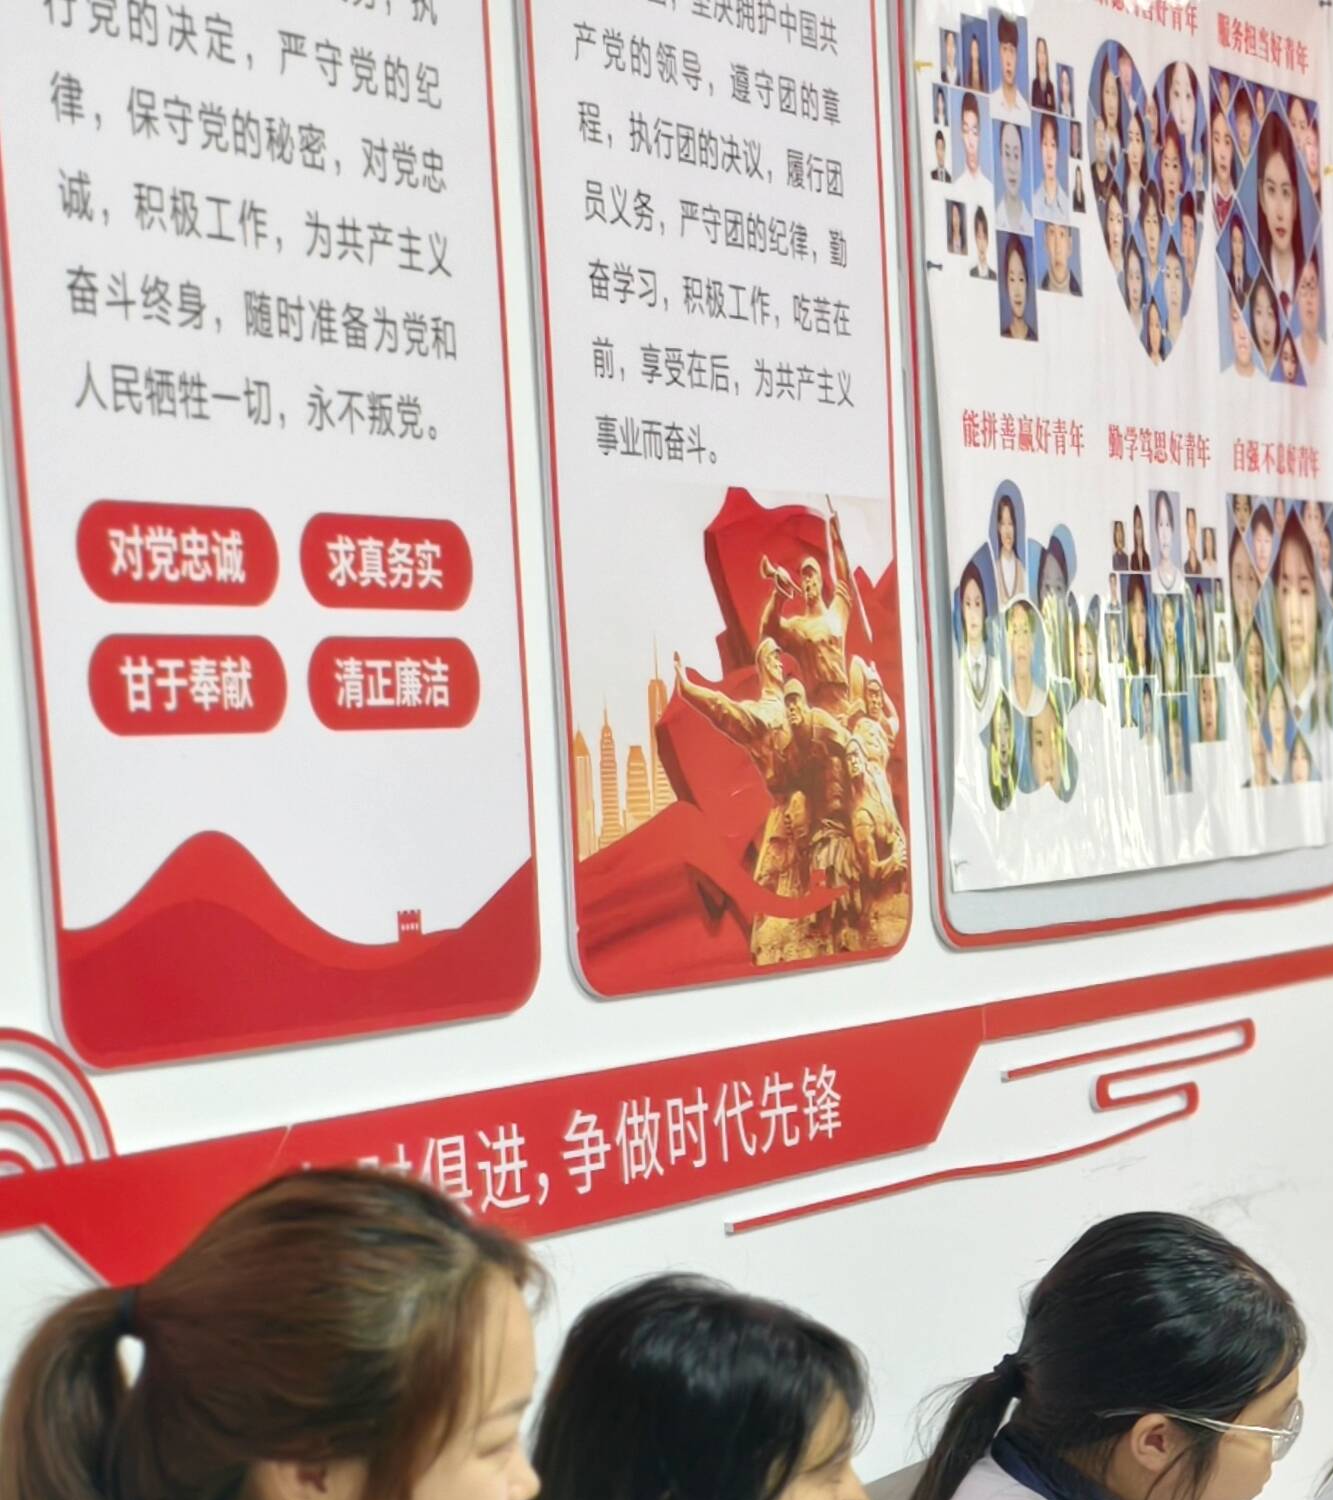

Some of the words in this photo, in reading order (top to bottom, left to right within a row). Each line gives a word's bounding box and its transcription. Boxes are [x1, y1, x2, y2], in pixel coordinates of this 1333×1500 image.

[573, 21, 842, 126] 产党的领导，遵守团的章
[50, 70, 448, 194] 律，保守党的秘密，对党忠
[577, 100, 844, 198] 程，执行团的决议，履行团
[58, 169, 453, 278] 诚，积极工作，为共产主义
[584, 179, 847, 269] 员义务，严守团的纪律，勤
[66, 265, 458, 361] 奋斗终身，随时准备为党和
[588, 257, 853, 338] 奋学习，积极工作，吃苦在
[74, 360, 442, 442] 人民牺牲一切，永不叛党。
[592, 336, 855, 408] 前，享受在后，为共产主义
[595, 415, 719, 466] 事业而奋斗。
[108, 523, 246, 585] 对党忠诚
[326, 535, 443, 590] 求真务实
[119, 655, 253, 713] 甘于奉献
[335, 655, 450, 709] 清正廉洁
[302, 1063, 842, 1213] 俱进，争做时代先锋
